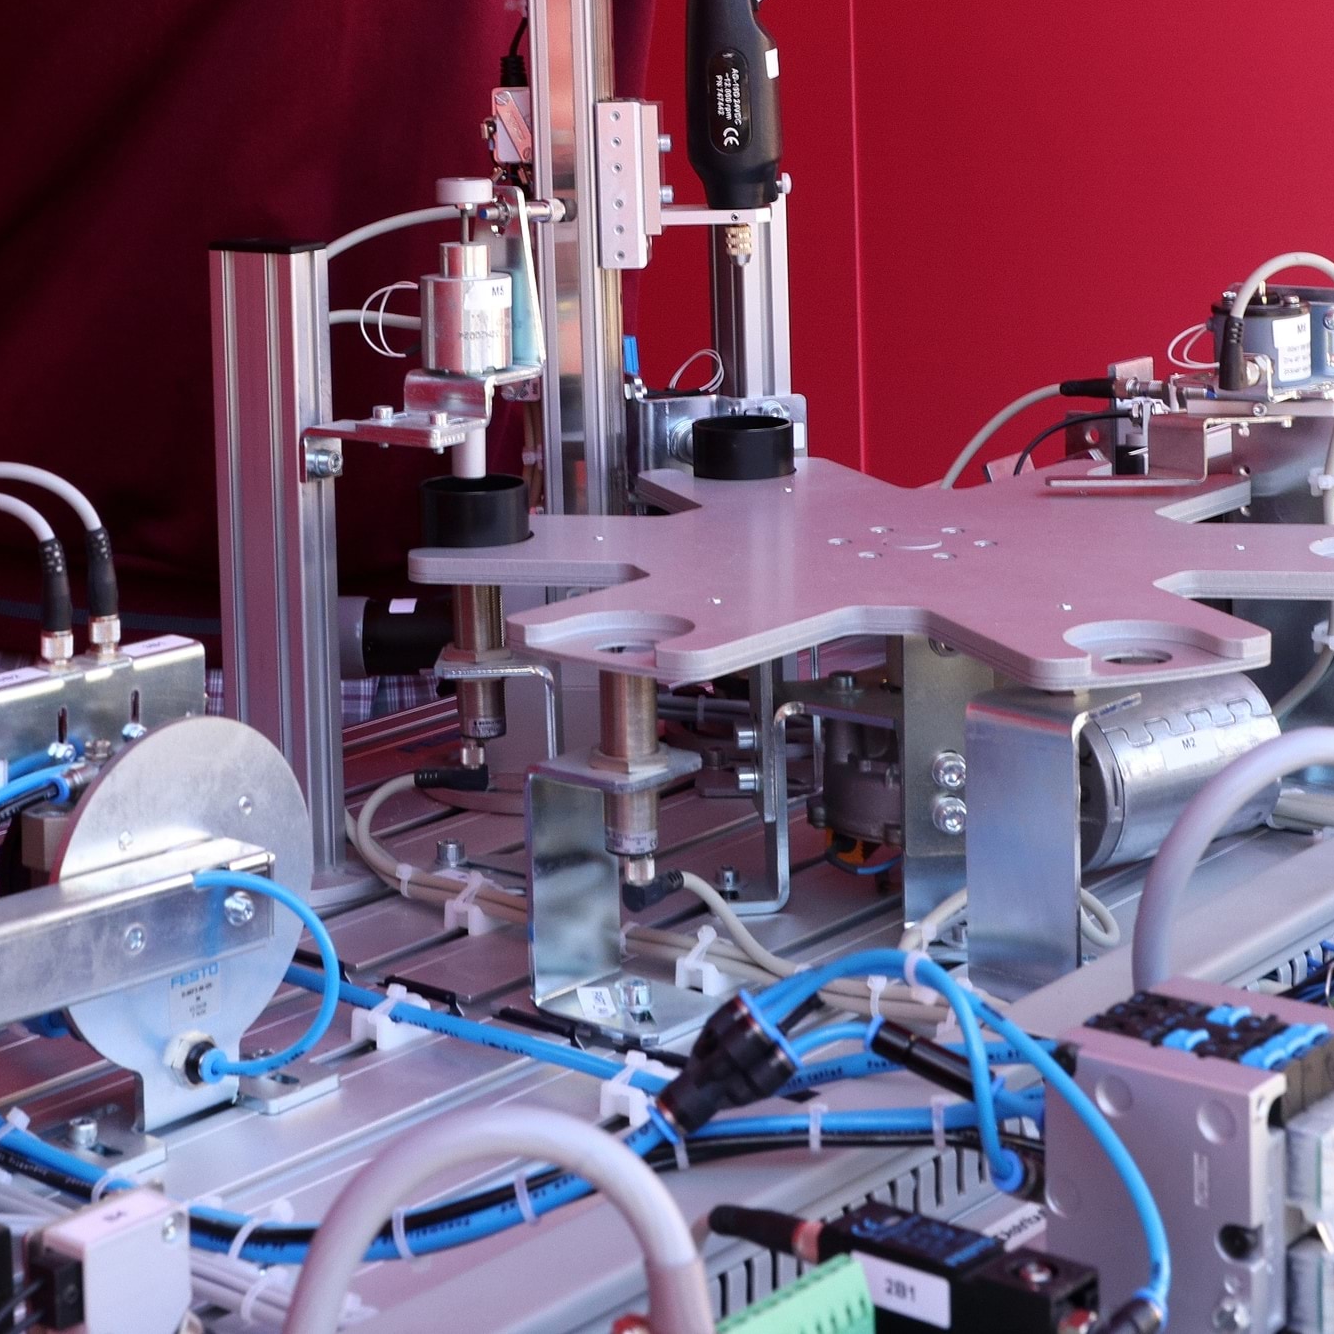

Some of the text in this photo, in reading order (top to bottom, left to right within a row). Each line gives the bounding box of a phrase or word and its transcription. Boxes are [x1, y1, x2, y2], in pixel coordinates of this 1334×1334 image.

[1181, 736, 1197, 751] M2
[170, 961, 219, 990] FESTO
[884, 1278, 916, 1301] 2B1
